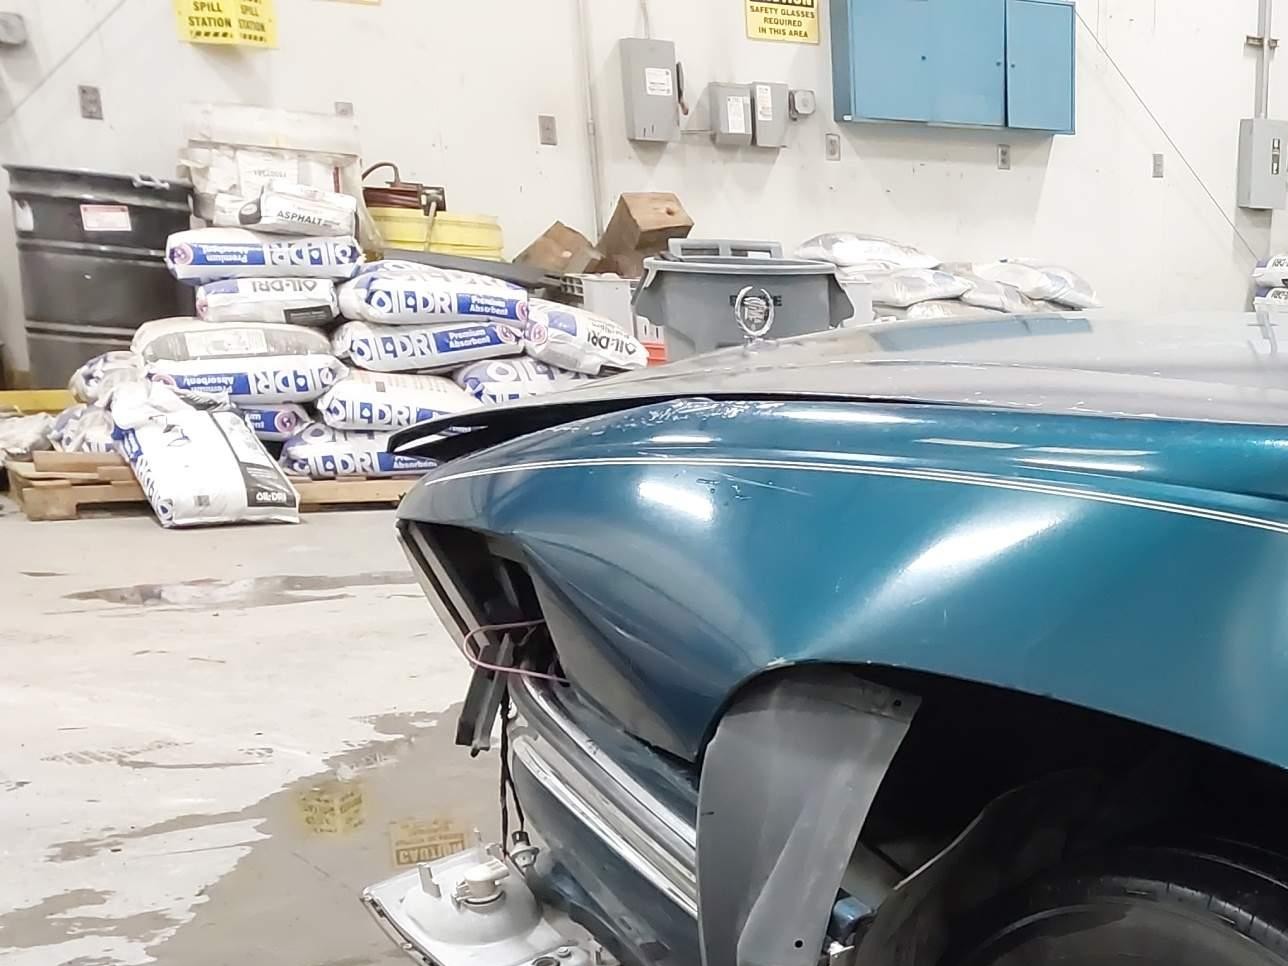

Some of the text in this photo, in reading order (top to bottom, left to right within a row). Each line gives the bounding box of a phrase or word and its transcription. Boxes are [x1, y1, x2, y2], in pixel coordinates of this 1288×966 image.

[193, 2, 222, 12] SPILL
[750, 5, 815, 19] SAFETY GLASSES
[188, 16, 232, 28] STATION
[763, 17, 802, 27] REQUIRED
[769, 28, 786, 36] THIS
[789, 30, 808, 38] AREA
[276, 210, 323, 226] ASPHALT
[469, 303, 508, 316] Absorbent
[449, 328, 486, 341] Premium
[449, 336, 491, 349] Absorbent
